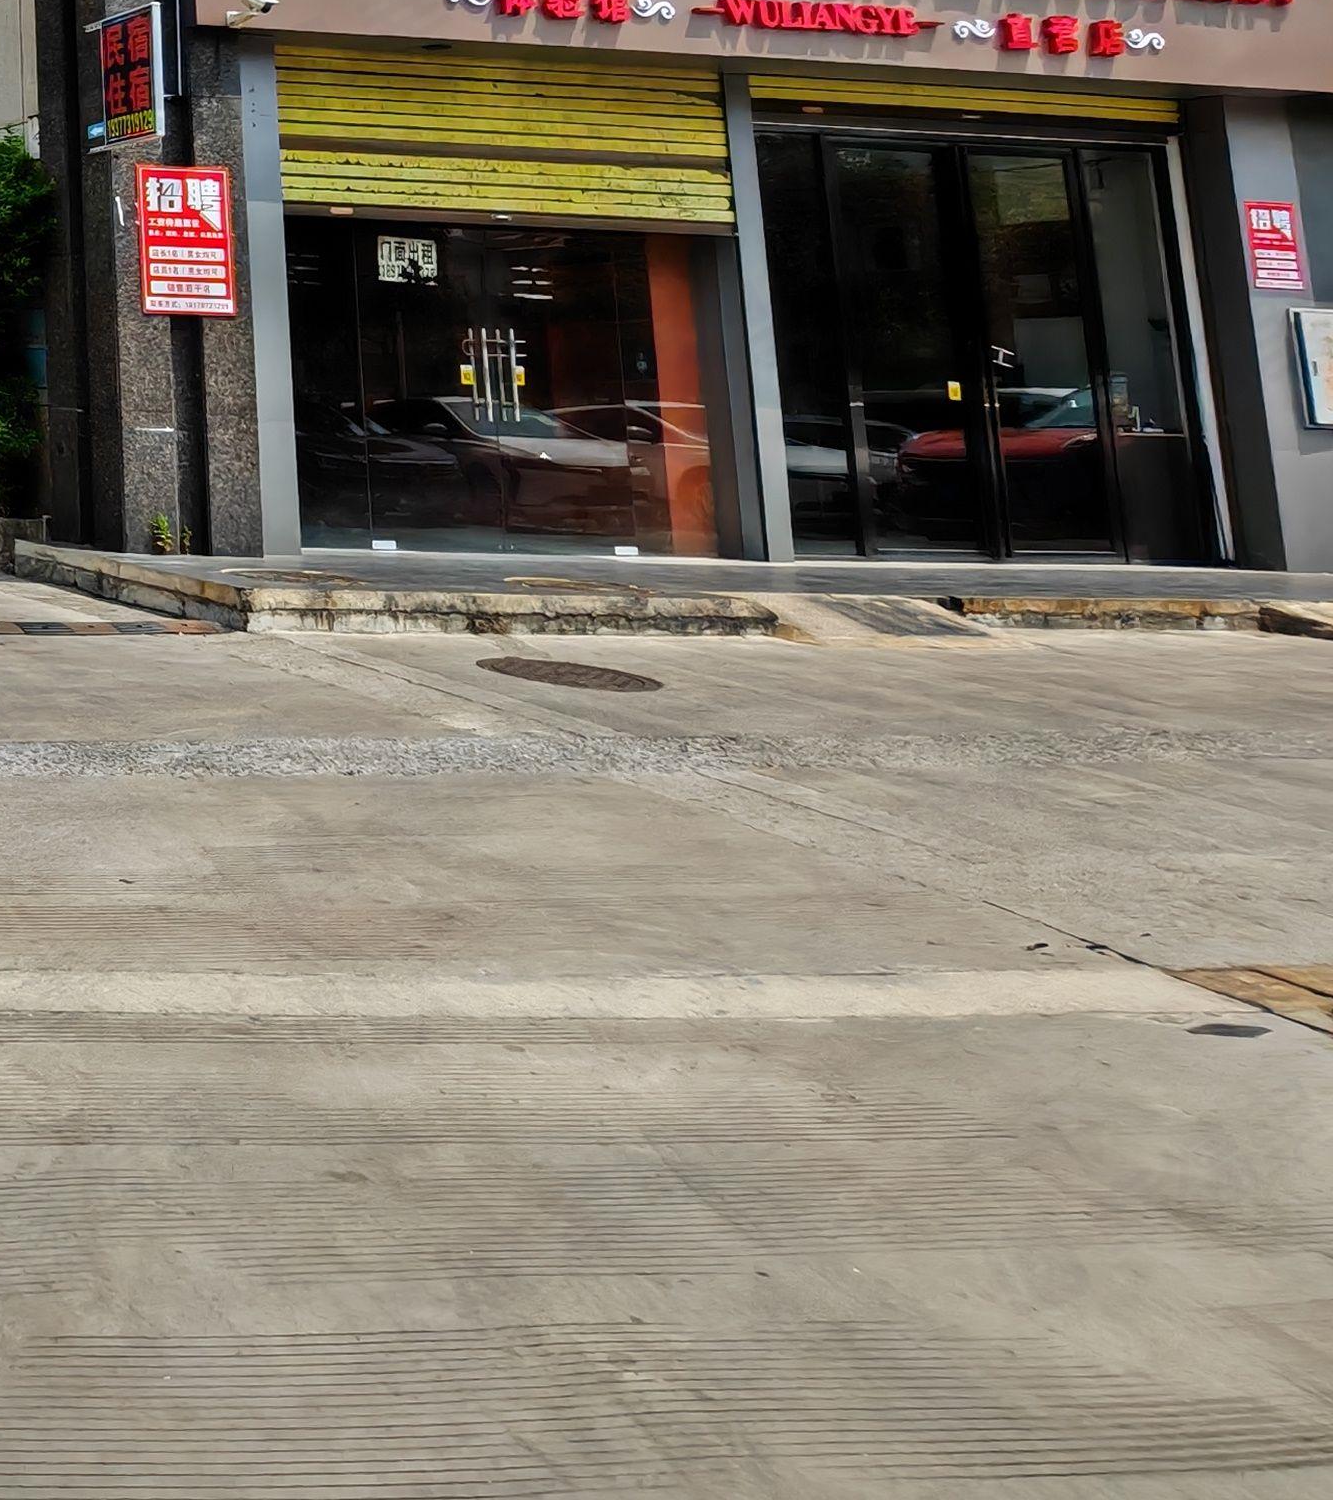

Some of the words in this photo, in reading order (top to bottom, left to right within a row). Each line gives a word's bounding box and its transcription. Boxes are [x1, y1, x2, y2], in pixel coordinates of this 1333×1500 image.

[999, 13, 1126, 58] 直营店
[146, 177, 223, 231] 招聘
